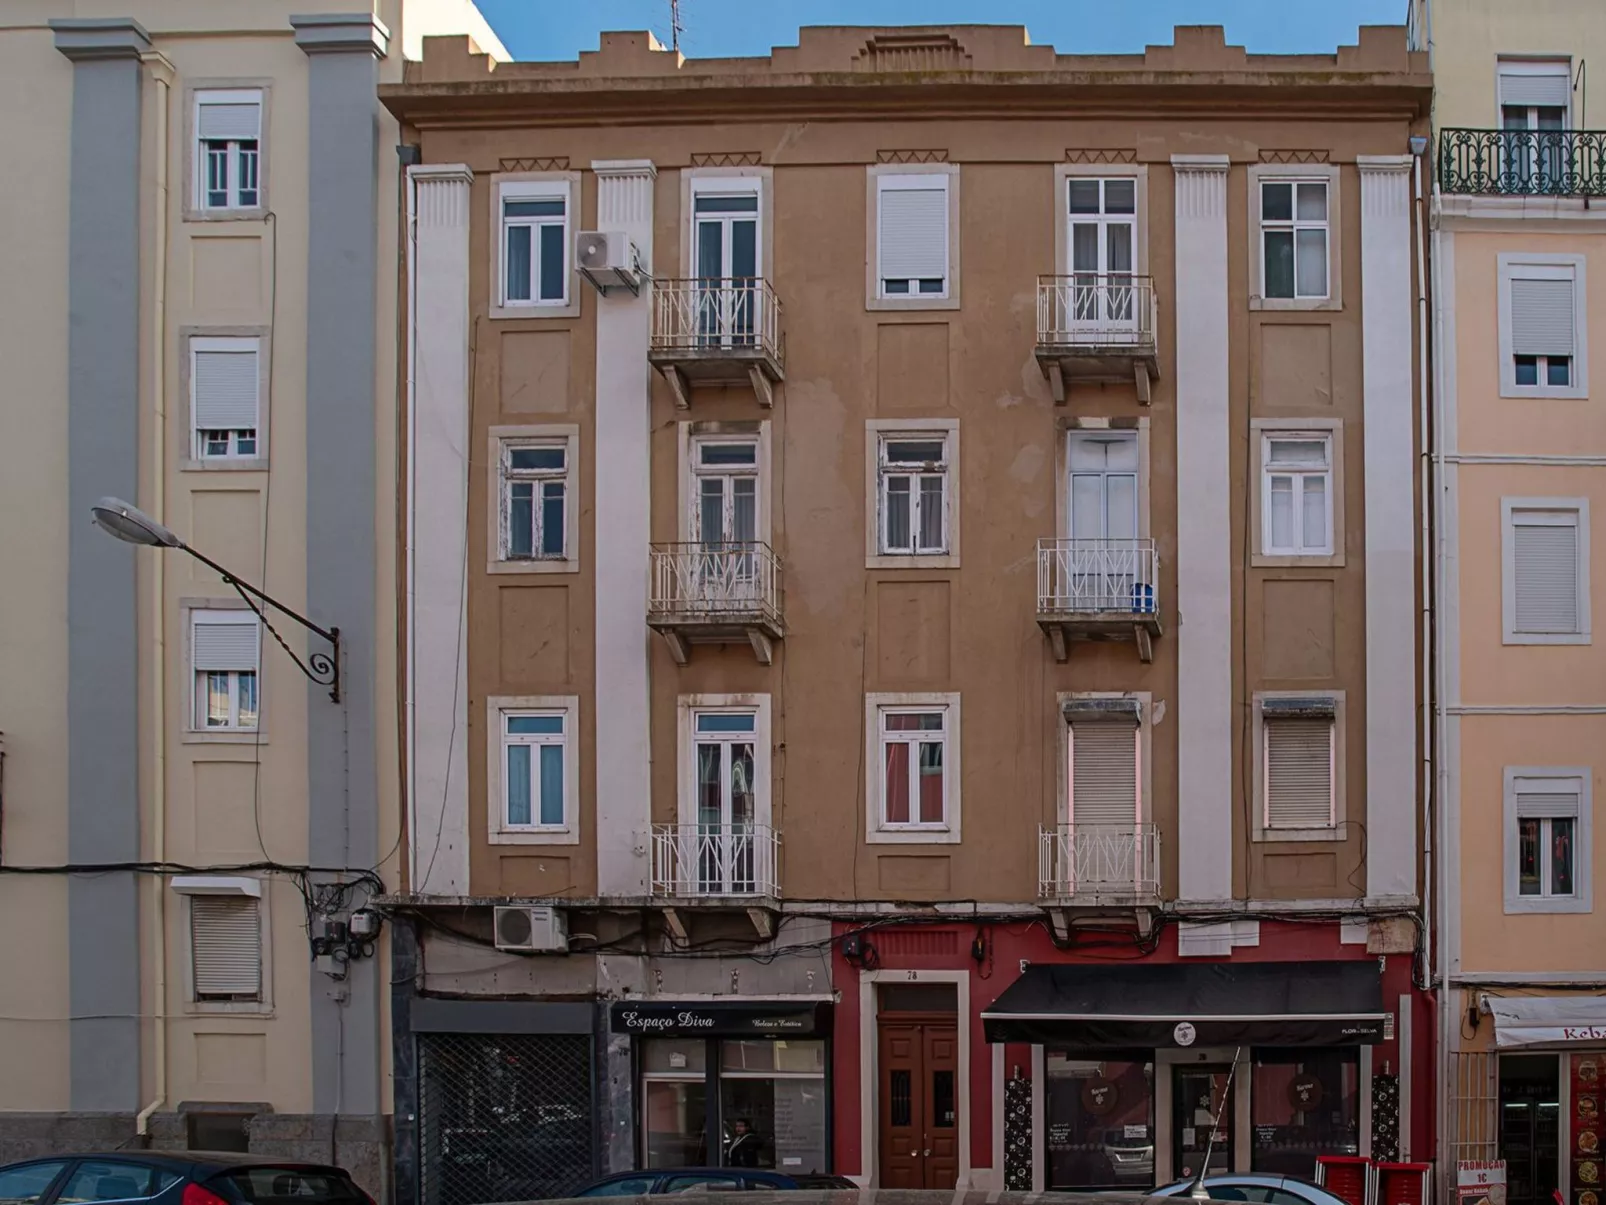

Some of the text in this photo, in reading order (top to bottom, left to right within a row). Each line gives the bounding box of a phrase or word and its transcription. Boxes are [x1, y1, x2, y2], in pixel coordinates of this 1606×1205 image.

[907, 970, 918, 980] 78
[622, 1011, 715, 1032] Espaço Diva
